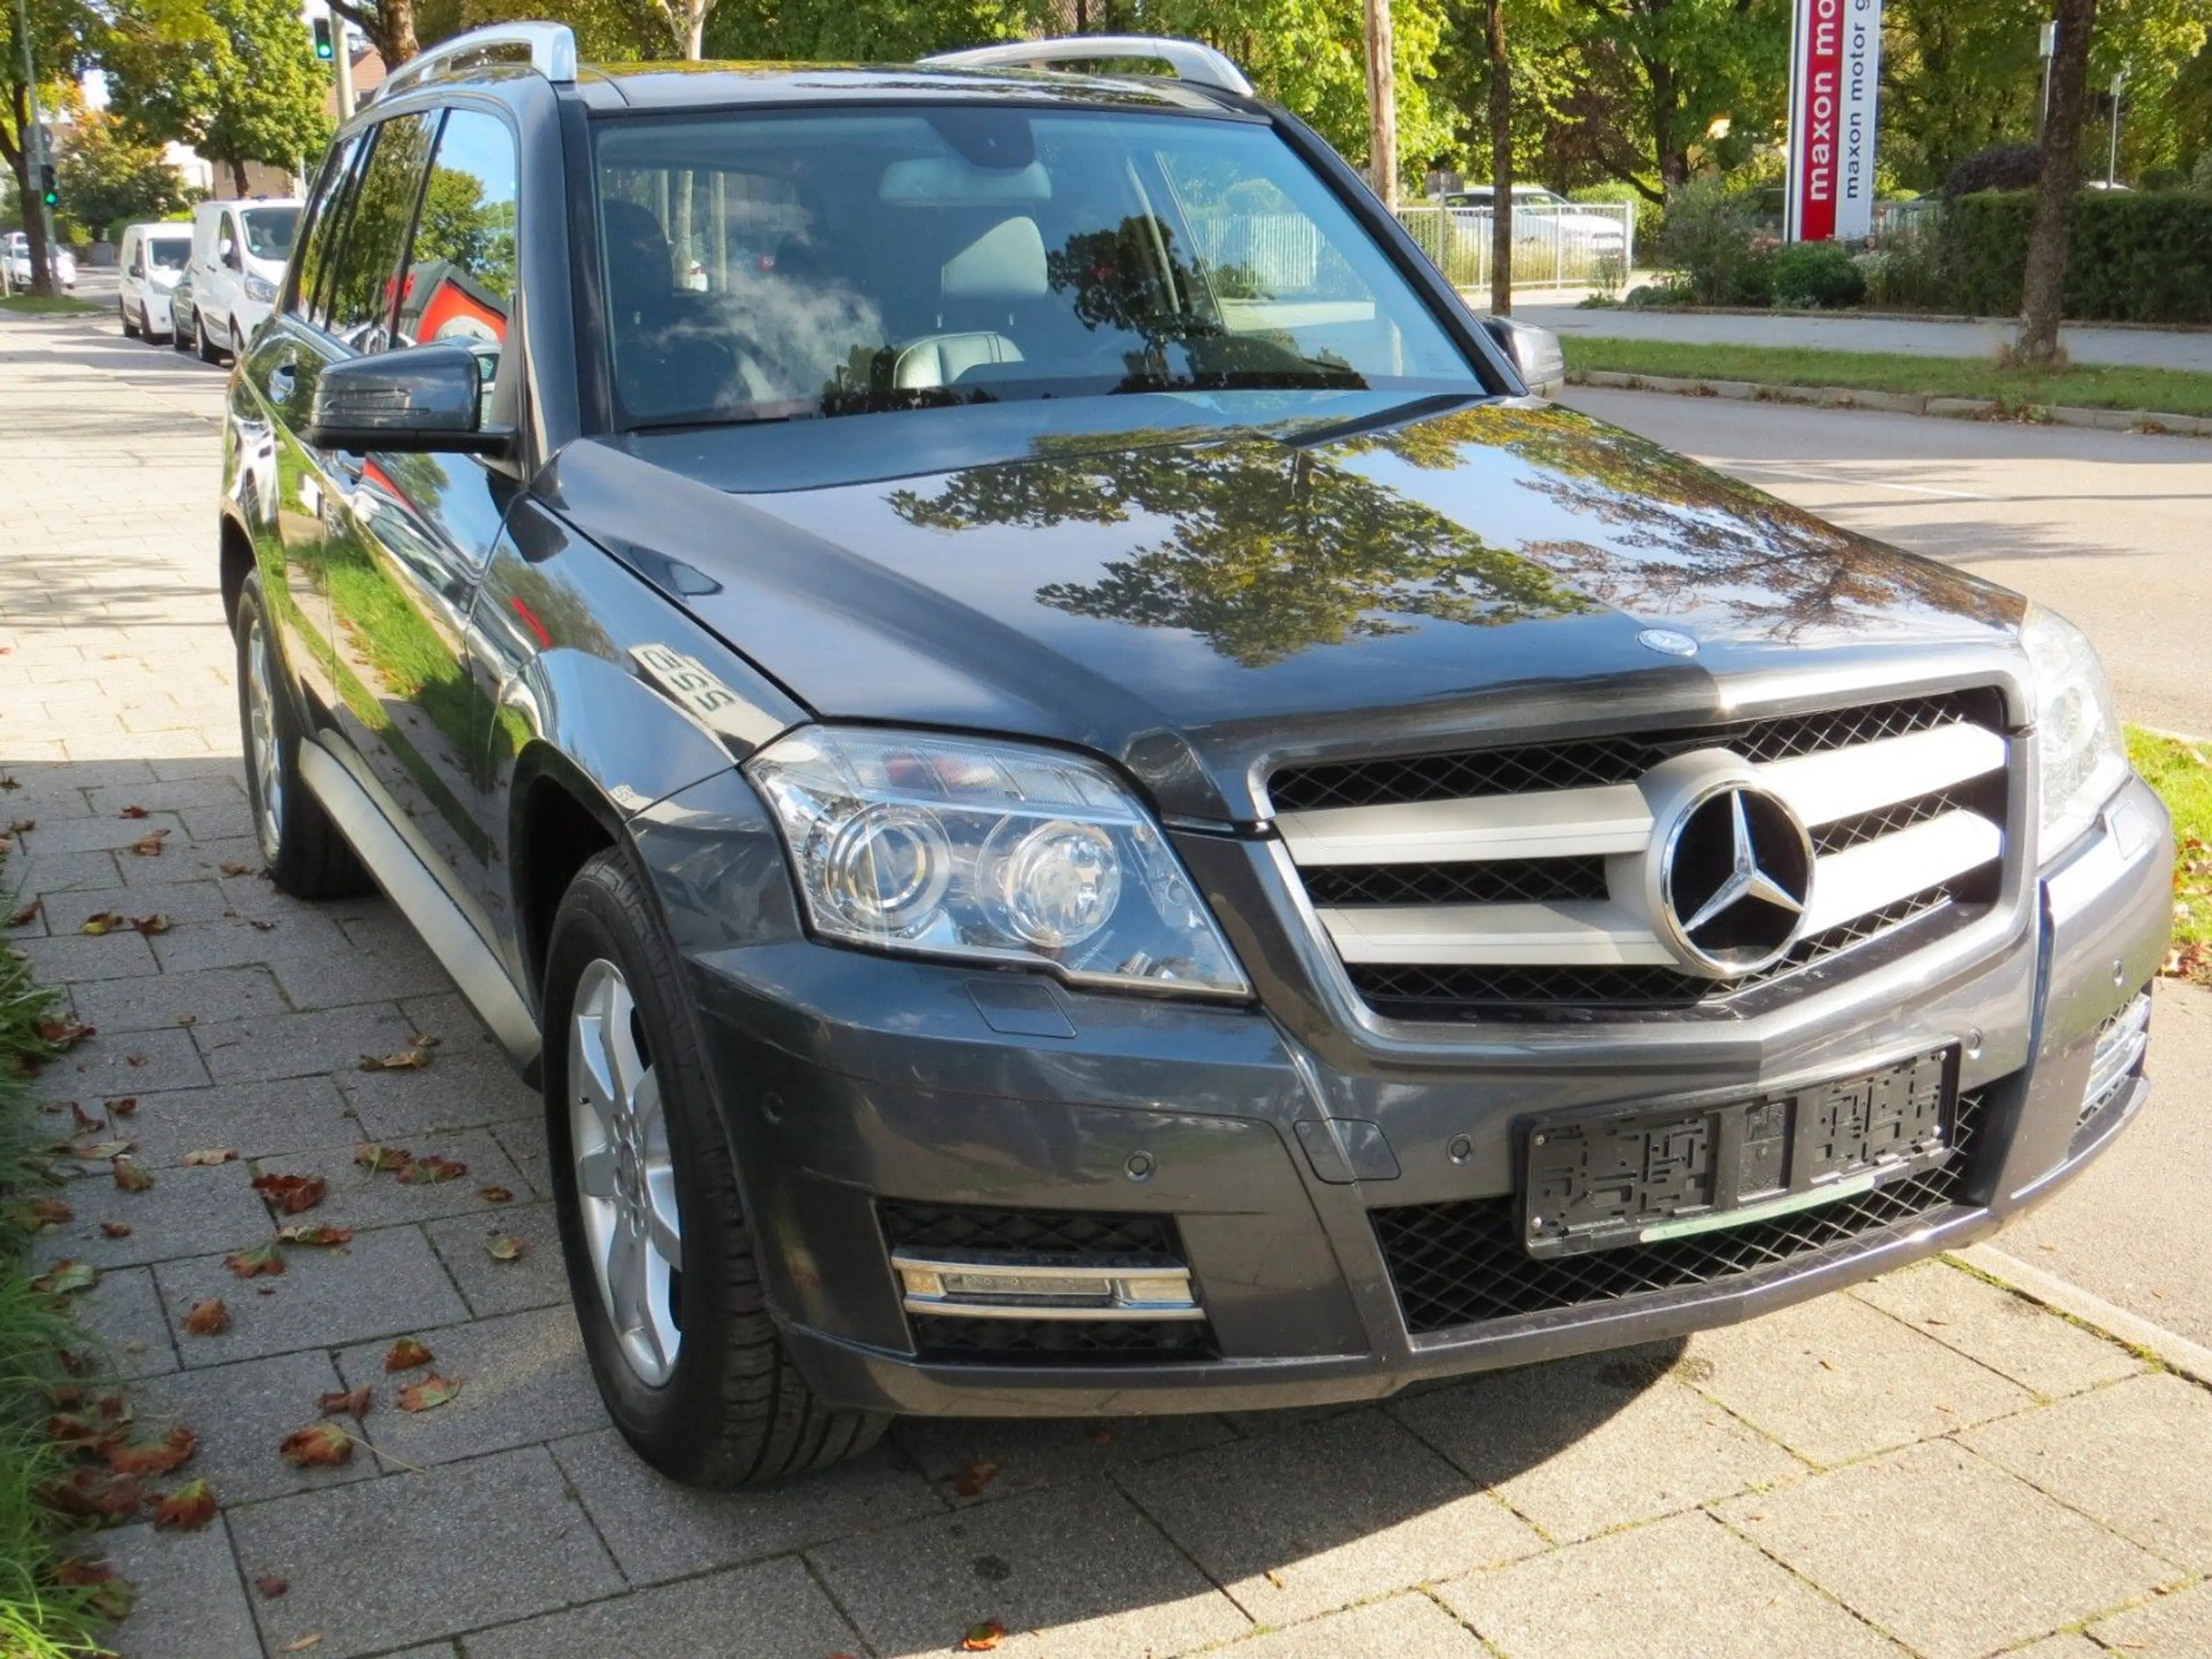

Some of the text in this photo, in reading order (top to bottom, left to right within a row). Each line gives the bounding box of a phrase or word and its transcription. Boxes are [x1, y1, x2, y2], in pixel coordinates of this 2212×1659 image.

[1810, 0, 1835, 200] maxon mo
[1850, 22, 1866, 101] motor
[1847, 113, 1862, 198] maxon
